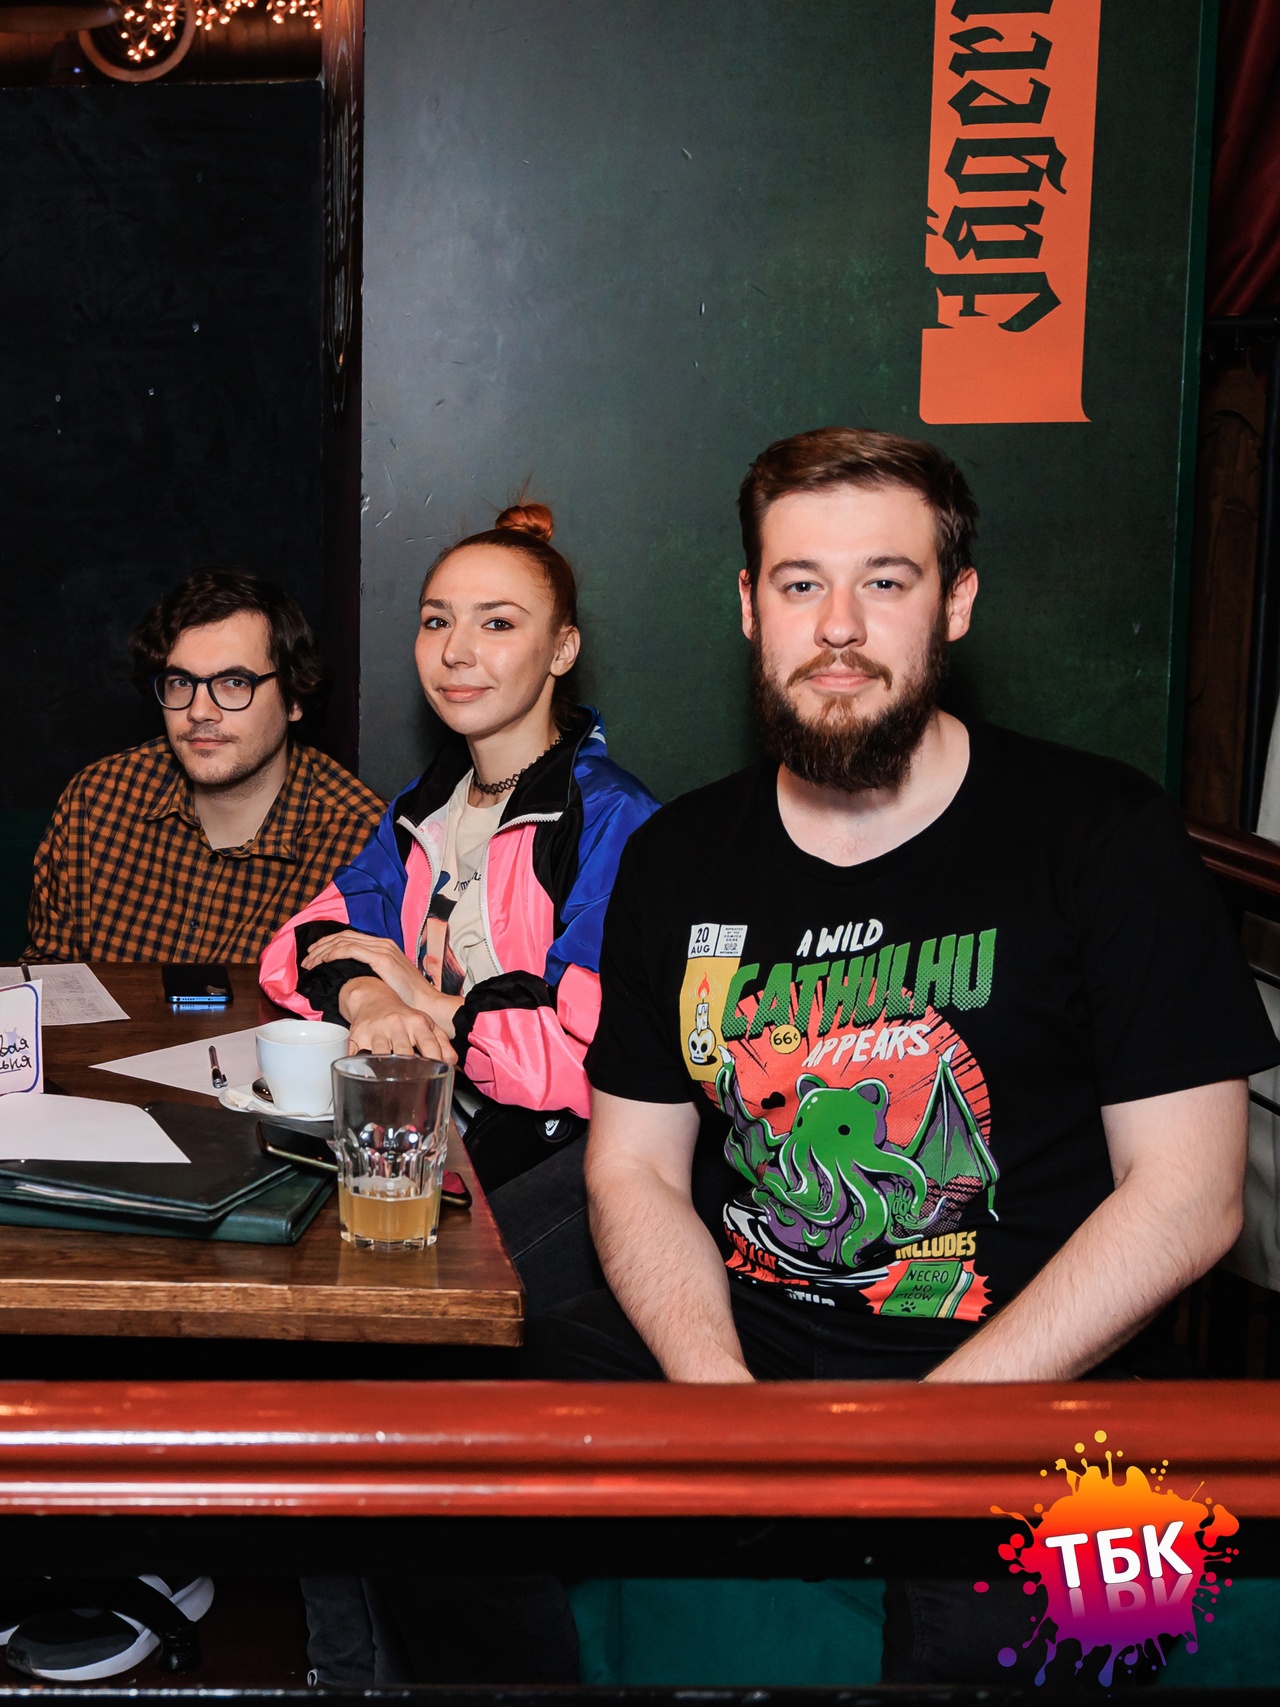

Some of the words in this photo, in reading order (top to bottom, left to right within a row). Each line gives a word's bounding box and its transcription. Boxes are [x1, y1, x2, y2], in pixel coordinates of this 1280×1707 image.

[695, 926, 710, 943] 20
[797, 929, 813, 957] A
[816, 918, 884, 957] WILD
[691, 945, 710, 955] AUG
[721, 928, 997, 1041] CATHULHU
[801, 1023, 932, 1068] APPEARS
[895, 1230, 977, 1260] INCLUDES
[906, 1269, 950, 1284] NECRO
[911, 1284, 933, 1293] NO
